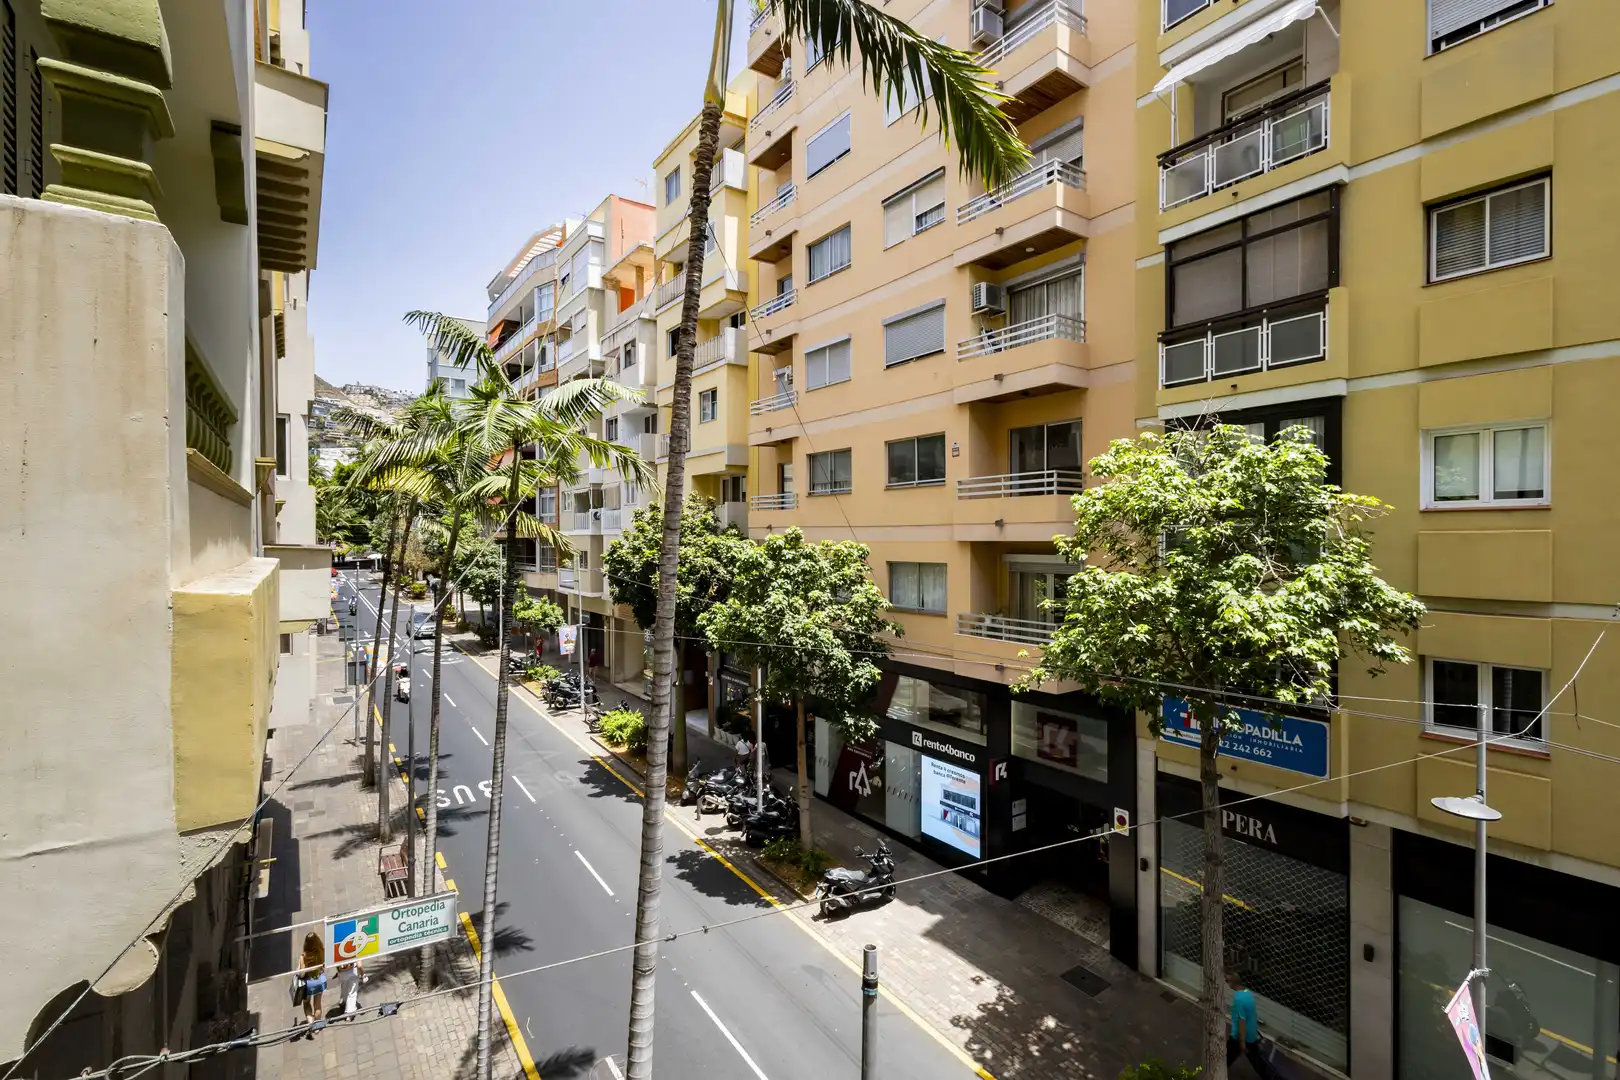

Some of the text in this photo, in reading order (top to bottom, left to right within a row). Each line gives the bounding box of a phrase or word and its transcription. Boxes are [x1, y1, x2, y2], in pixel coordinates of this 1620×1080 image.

[923, 739, 976, 762] renta4banco
[1233, 742, 1251, 753] 242
[1253, 747, 1272, 758] 662
[1250, 738, 1303, 754] INMOBILIARIA
[1221, 809, 1278, 844] PERA
[391, 899, 446, 920] Ortopedia
[398, 915, 439, 933] Canaria
[389, 932, 423, 945] ortopedia
